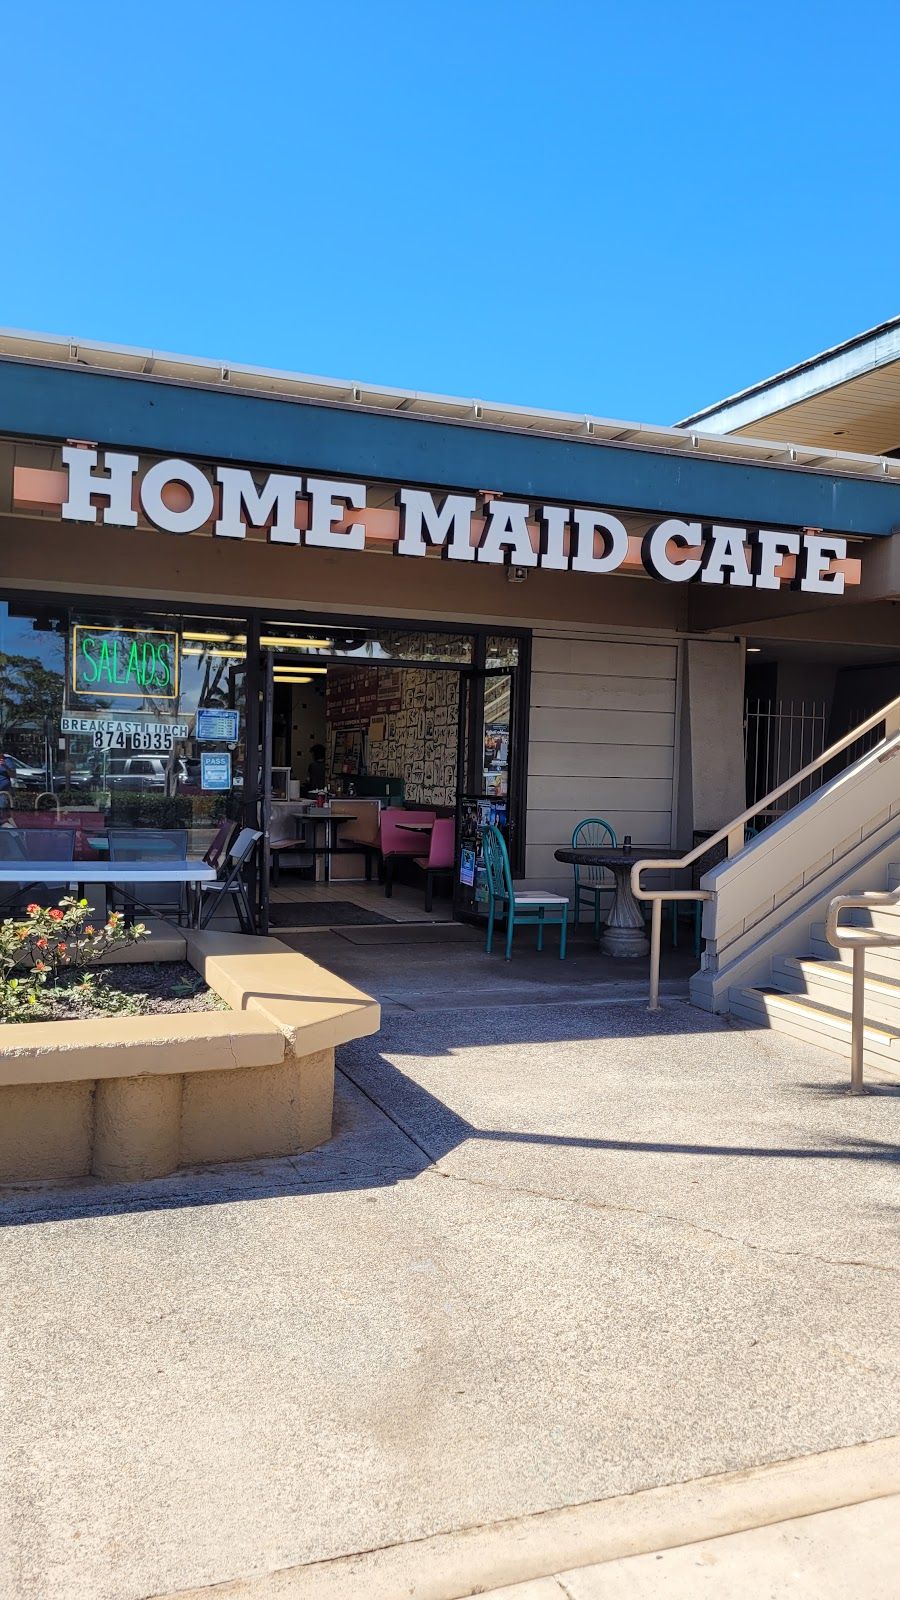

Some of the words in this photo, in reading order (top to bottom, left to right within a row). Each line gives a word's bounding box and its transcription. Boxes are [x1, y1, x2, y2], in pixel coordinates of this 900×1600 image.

[61, 446, 366, 550] HOME
[398, 488, 629, 573] MAID
[646, 518, 847, 595] CAFE
[82, 638, 170, 686] SALADS
[62, 718, 141, 734] BREAKFAST
[145, 723, 188, 737] LUNCH
[95, 731, 125, 748] 874
[132, 732, 172, 749] 6035
